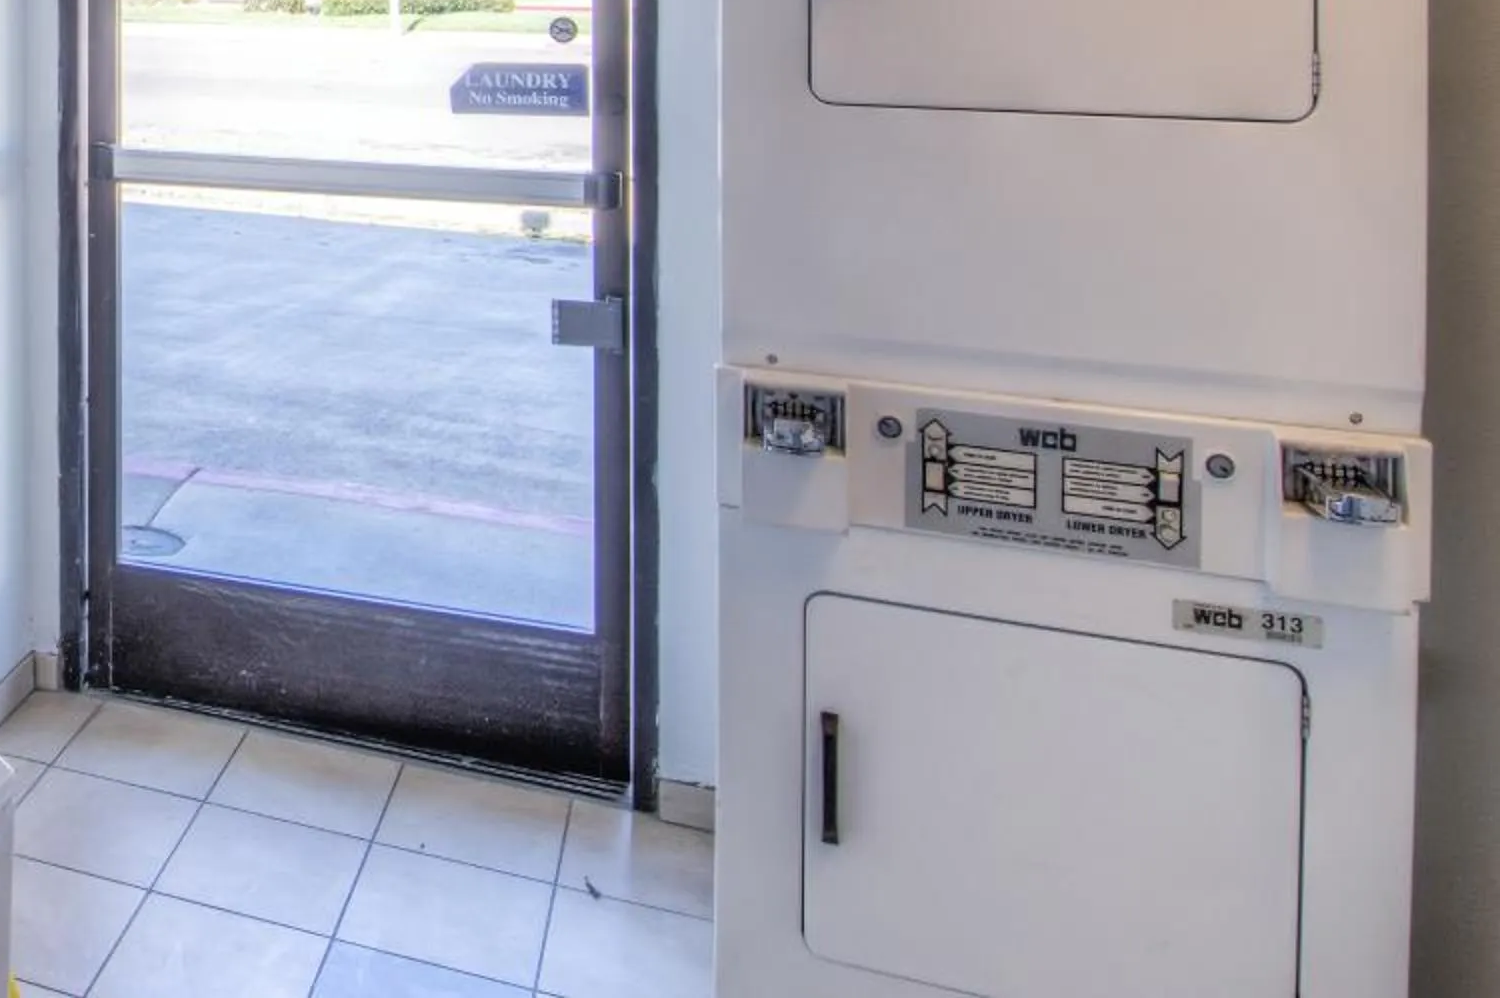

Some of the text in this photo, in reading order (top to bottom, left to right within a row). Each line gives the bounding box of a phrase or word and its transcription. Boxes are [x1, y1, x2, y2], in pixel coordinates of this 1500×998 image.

[465, 72, 572, 90] LAUNDRY
[468, 90, 570, 109] No Smoking
[957, 504, 1033, 524] UPPER DRYER
[1066, 519, 1148, 540] LOWER DRYER
[1261, 613, 1304, 634] 313
